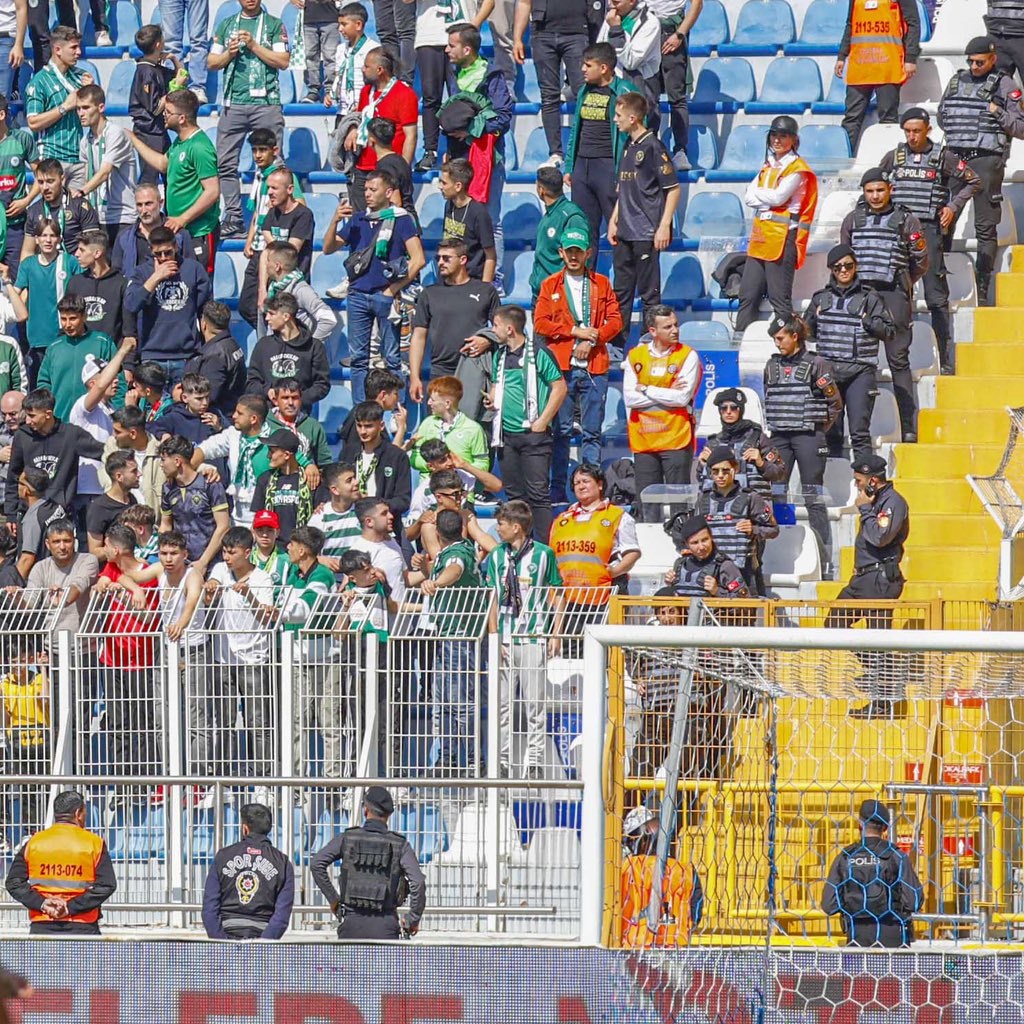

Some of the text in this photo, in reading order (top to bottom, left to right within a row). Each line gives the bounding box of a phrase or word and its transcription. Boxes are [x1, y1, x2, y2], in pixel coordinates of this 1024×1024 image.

[855, 21, 891, 34] 2113-535
[555, 540, 596, 554] 2113-359
[39, 863, 83, 877] 2113-074
[222, 853, 252, 878] SPOR
